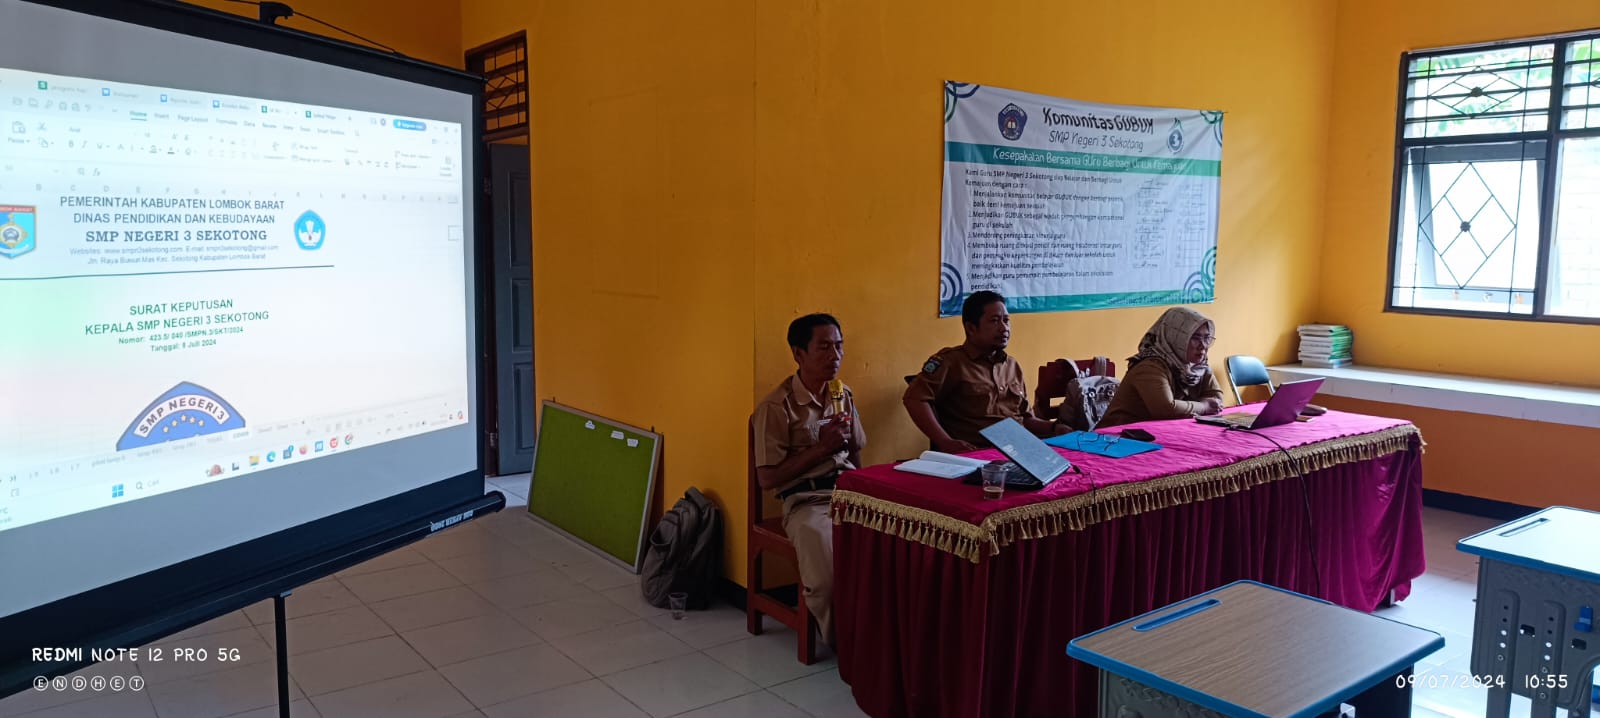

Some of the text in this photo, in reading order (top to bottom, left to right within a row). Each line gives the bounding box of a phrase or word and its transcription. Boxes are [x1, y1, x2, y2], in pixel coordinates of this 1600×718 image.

[1049, 130, 1070, 144] SMP
[1100, 135, 1107, 147] 3
[1109, 135, 1144, 152] Sekotong
[993, 148, 1044, 164] Kesepakatan
[1047, 152, 1081, 166] Bersama
[1006, 171, 1024, 179] Negeri
[60, 196, 285, 209] PEMERINTAH KABUPATEN LOMBOK BARAT
[73, 213, 275, 223] DINAS PENDIDIKAN DAN KEBUDAYAAN
[86, 230, 267, 242] SMP NEGERI 3 SEKOTONG
[130, 299, 233, 316] SURAT KEPUTUSAN
[85, 311, 269, 335] KEPALA SMP NEGERI 3 SEKOTONG
[118, 336, 145, 345] Nomor:
[202, 339, 217, 347] 2024
[139, 397, 225, 434] SMP NEGERI 3
